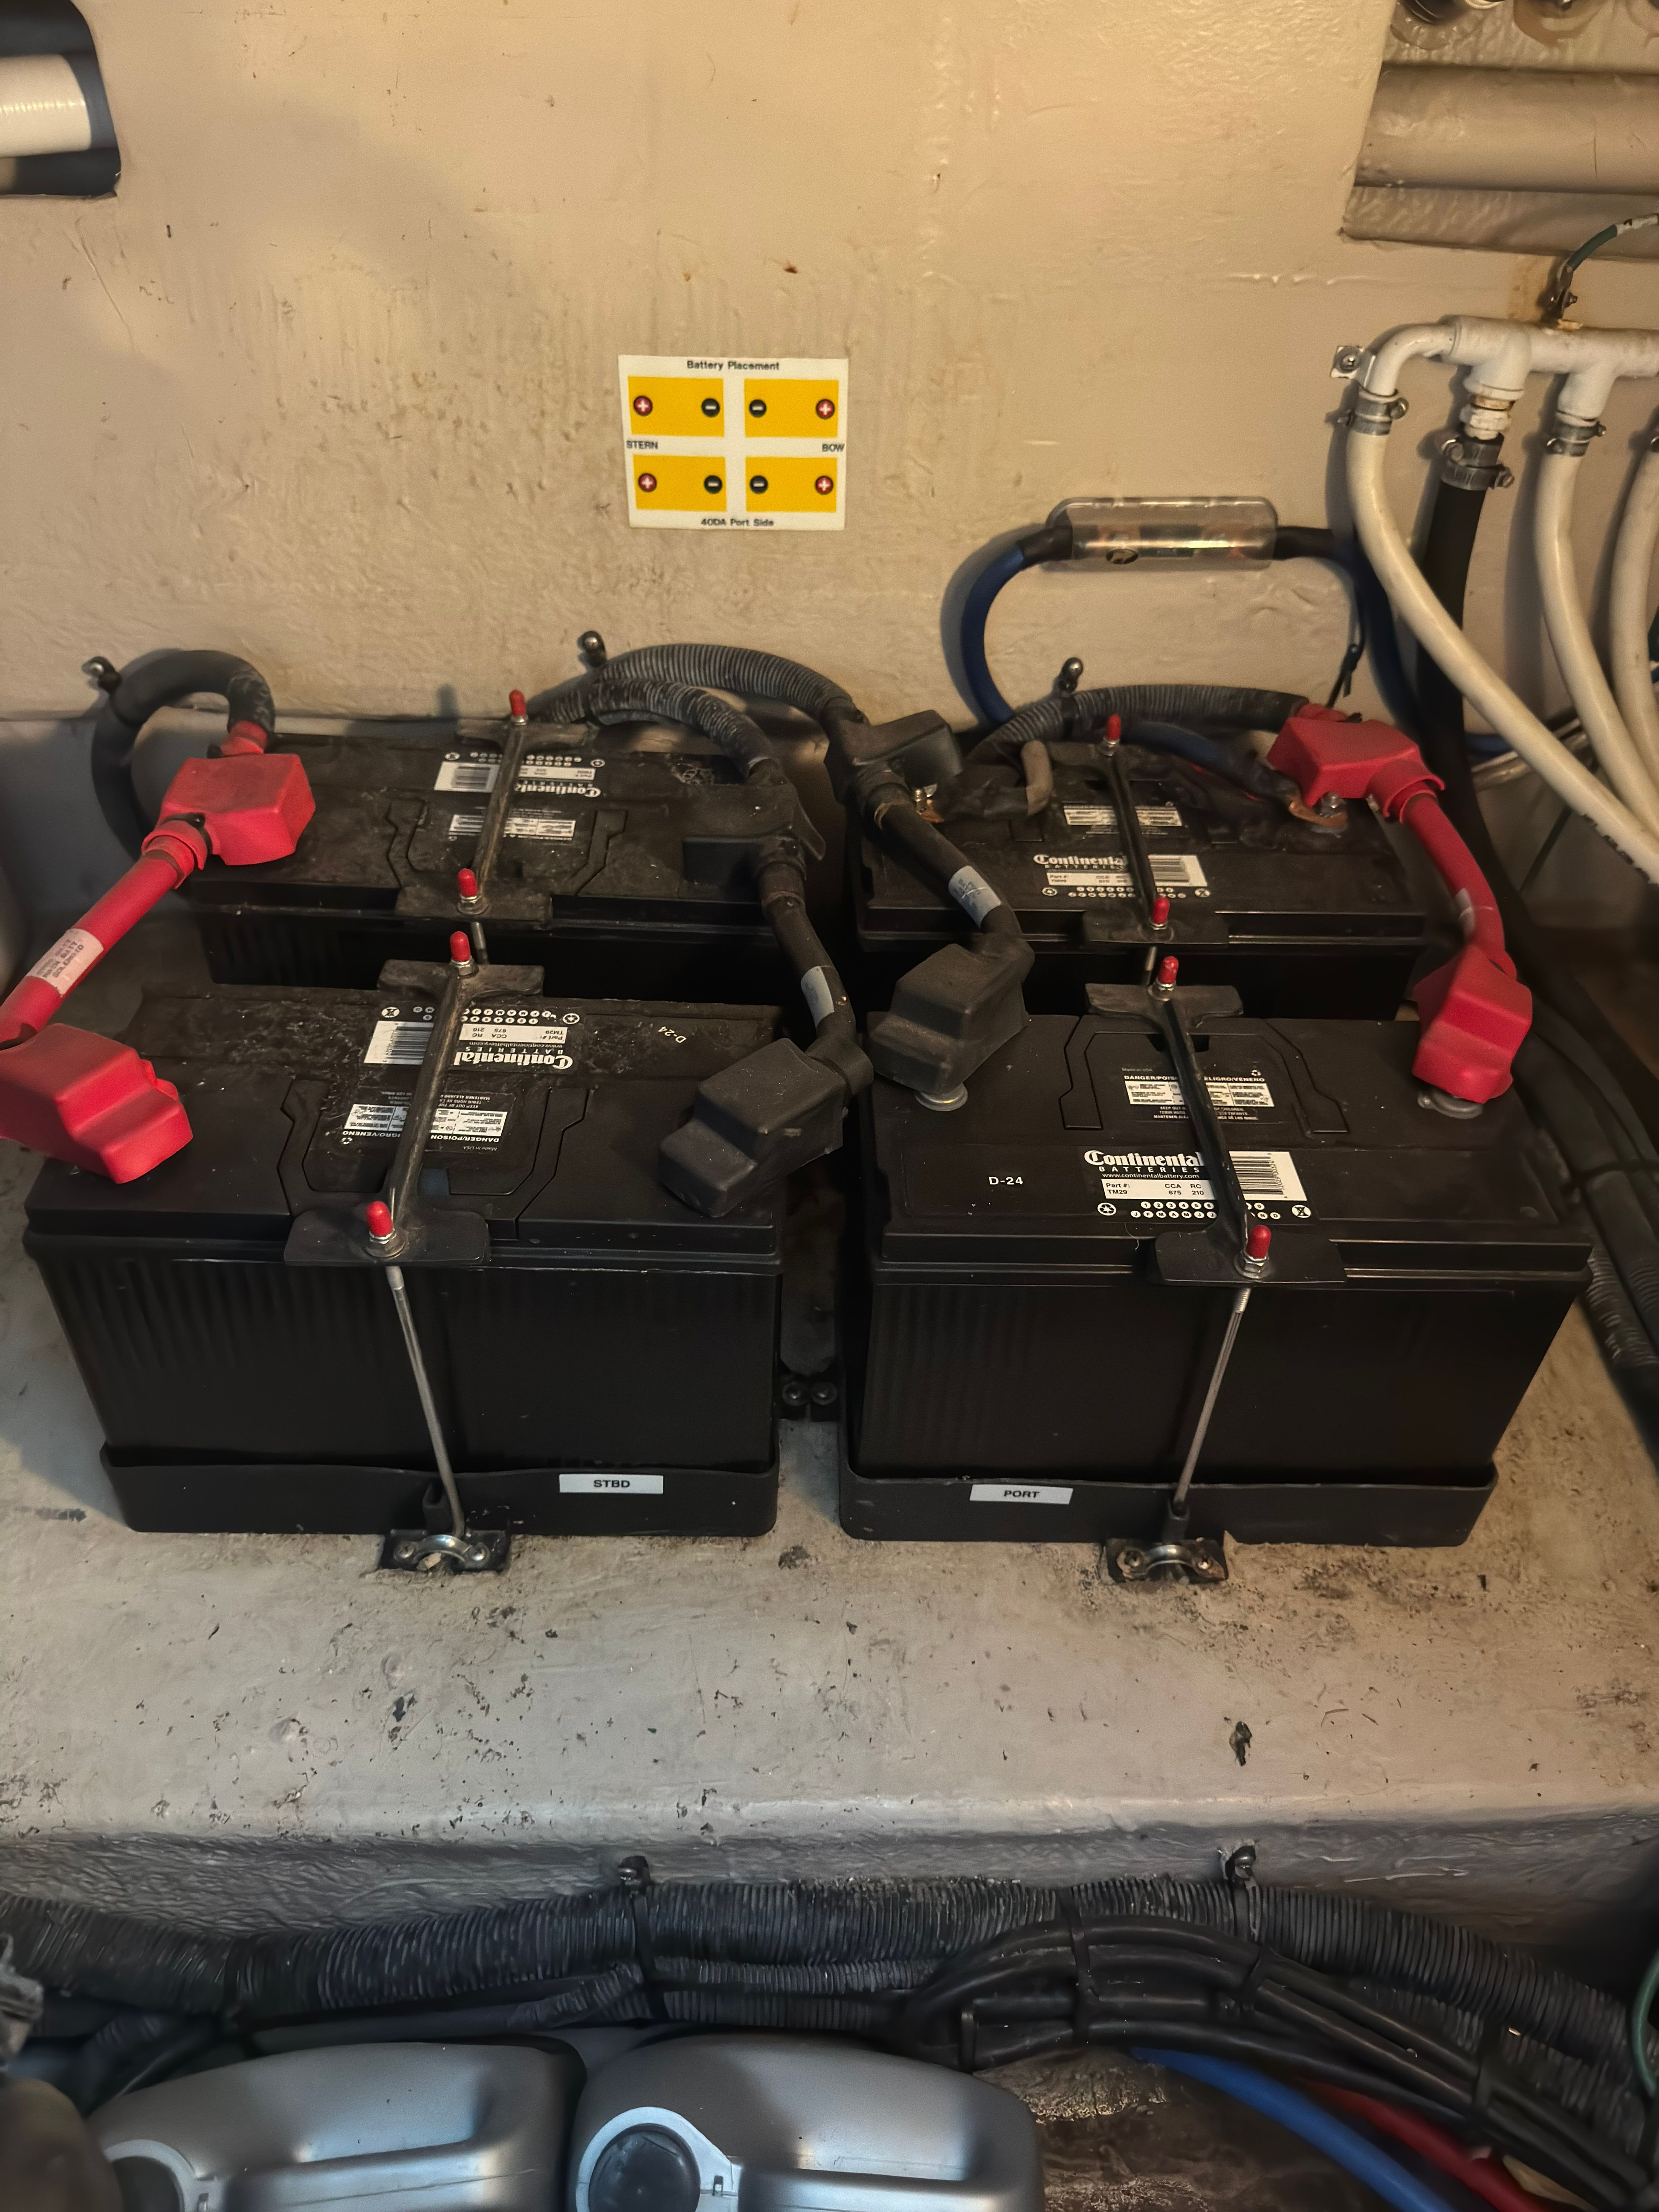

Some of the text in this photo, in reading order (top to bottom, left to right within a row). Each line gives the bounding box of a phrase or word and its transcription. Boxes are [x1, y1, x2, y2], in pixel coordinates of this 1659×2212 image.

[687, 361, 779, 371] Battery Placement
[626, 440, 658, 450] STERN
[821, 443, 845, 452] BOW
[730, 518, 749, 526] Port
[514, 784, 601, 797] Continenta
[658, 1026, 687, 1043] D-24
[453, 1052, 573, 1069] Continental
[1084, 1150, 1204, 1167] Continental
[988, 1176, 1024, 1185] D-24
[593, 1479, 630, 1488] STBD
[1003, 1490, 1040, 1498] PORT
